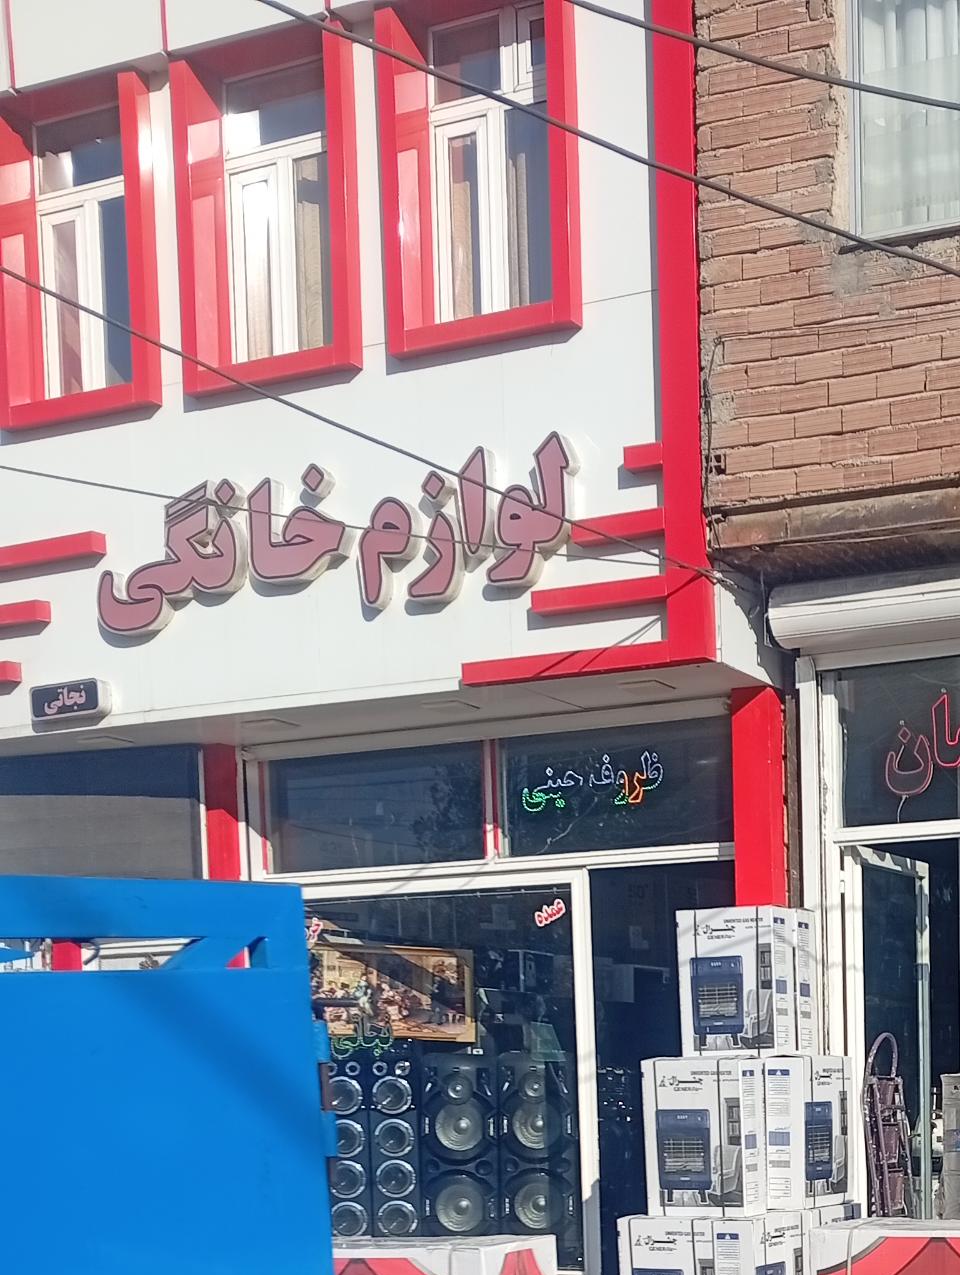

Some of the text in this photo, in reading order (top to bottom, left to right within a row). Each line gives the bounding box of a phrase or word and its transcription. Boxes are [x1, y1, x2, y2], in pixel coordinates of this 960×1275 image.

[97, 431, 571, 632] لوازم خانگی
[44, 684, 86, 715] نجاتی
